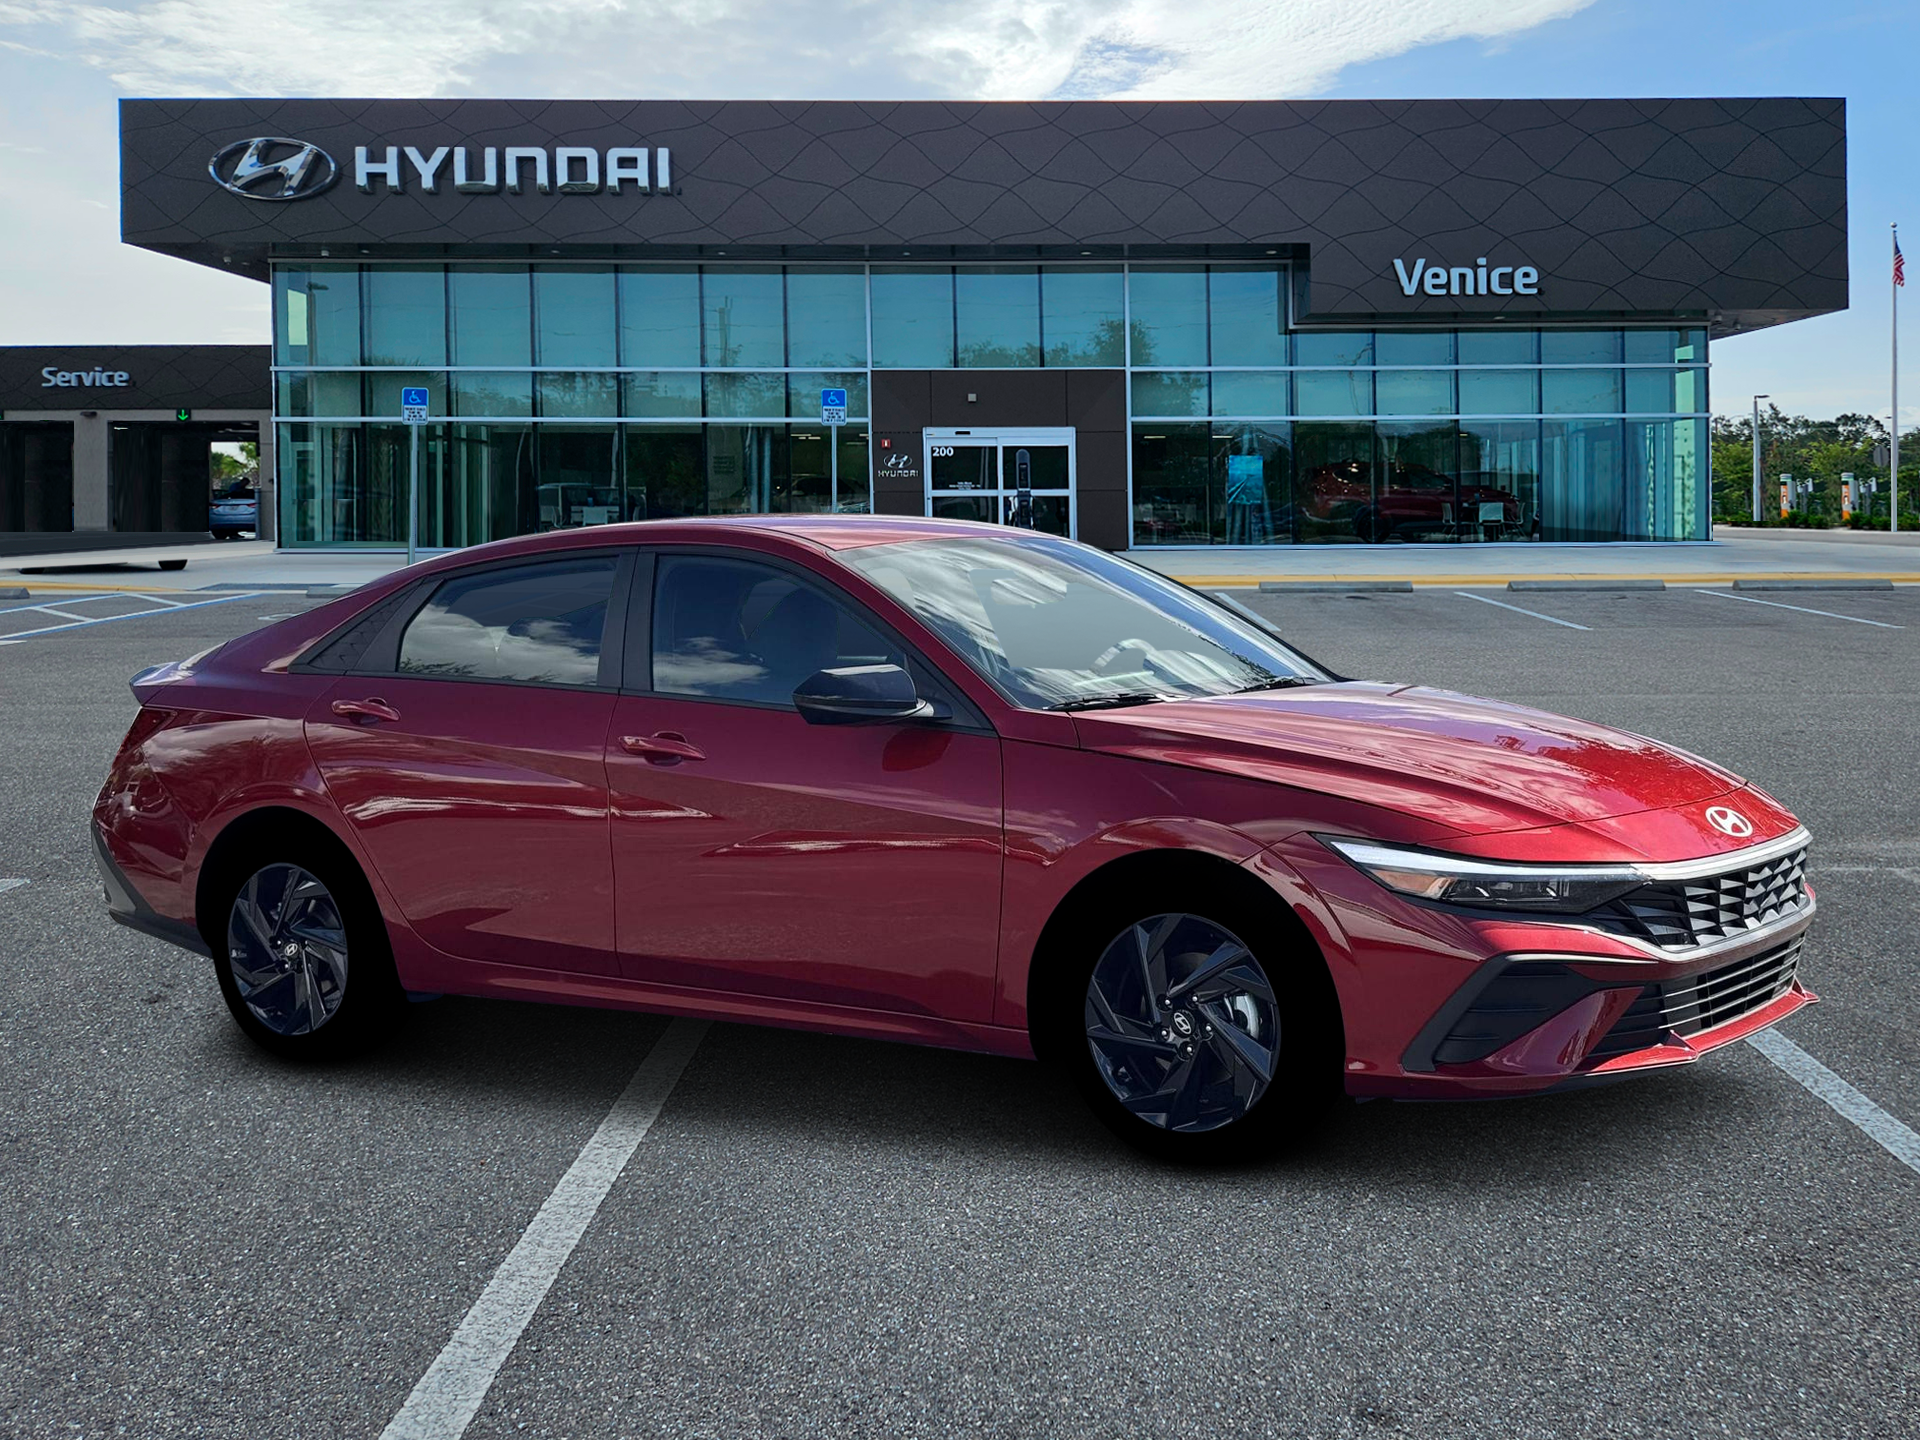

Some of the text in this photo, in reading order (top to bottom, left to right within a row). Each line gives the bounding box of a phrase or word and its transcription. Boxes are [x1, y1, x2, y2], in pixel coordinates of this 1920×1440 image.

[354, 146, 671, 194] HYUNDAI
[1393, 257, 1539, 295] Venice
[41, 366, 130, 387] Service
[932, 447, 954, 457] 200
[878, 470, 919, 478] HYUNDAI
